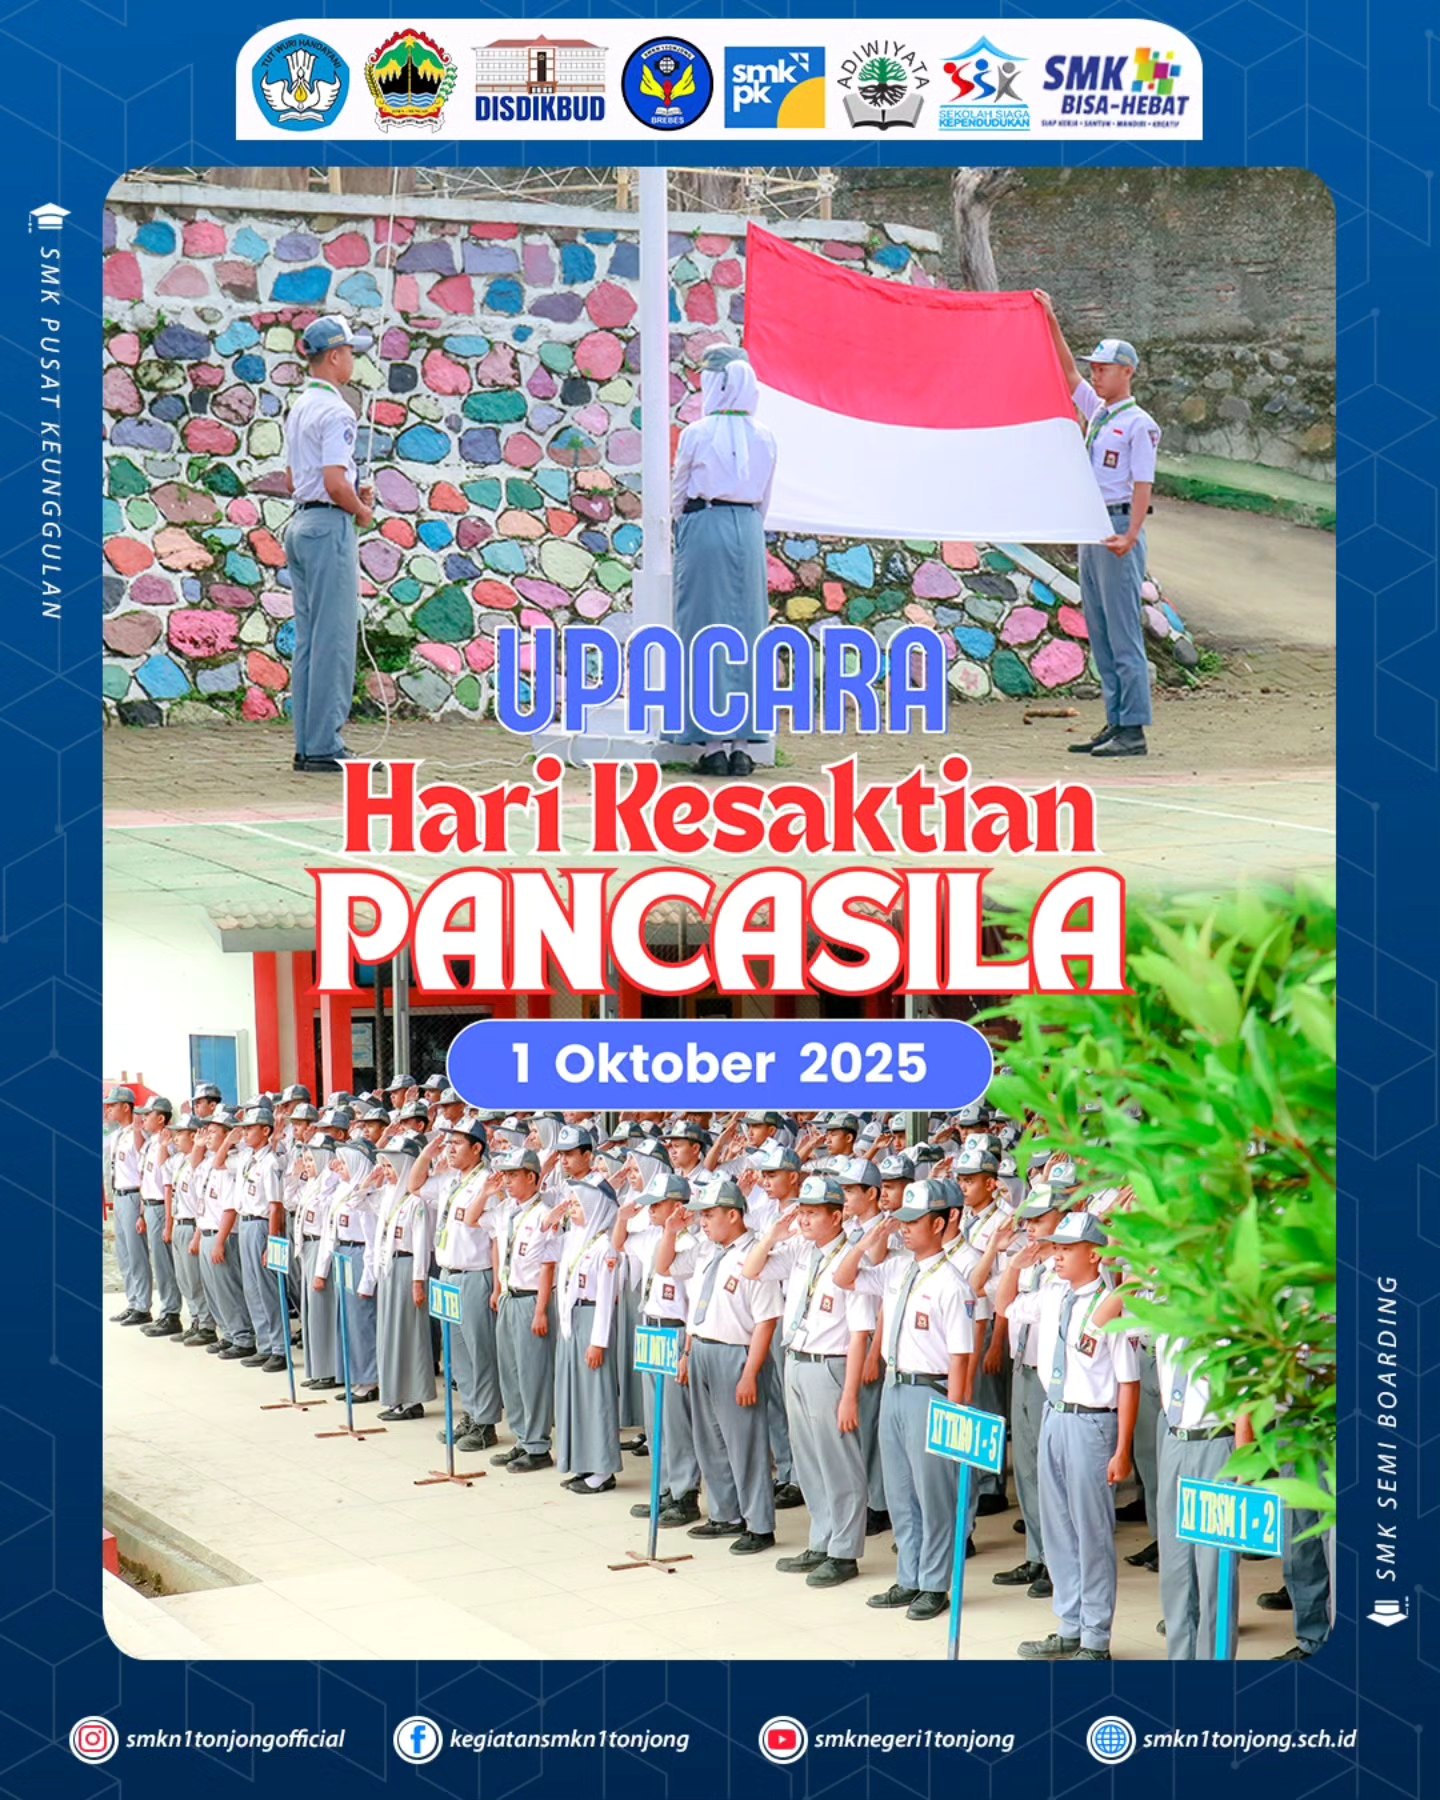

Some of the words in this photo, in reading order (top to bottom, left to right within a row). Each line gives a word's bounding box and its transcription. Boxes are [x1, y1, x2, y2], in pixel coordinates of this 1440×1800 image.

[1181, 1486, 1197, 1530] XI
[1239, 1497, 1247, 1540] 1
[1263, 1500, 1276, 1544] 2
